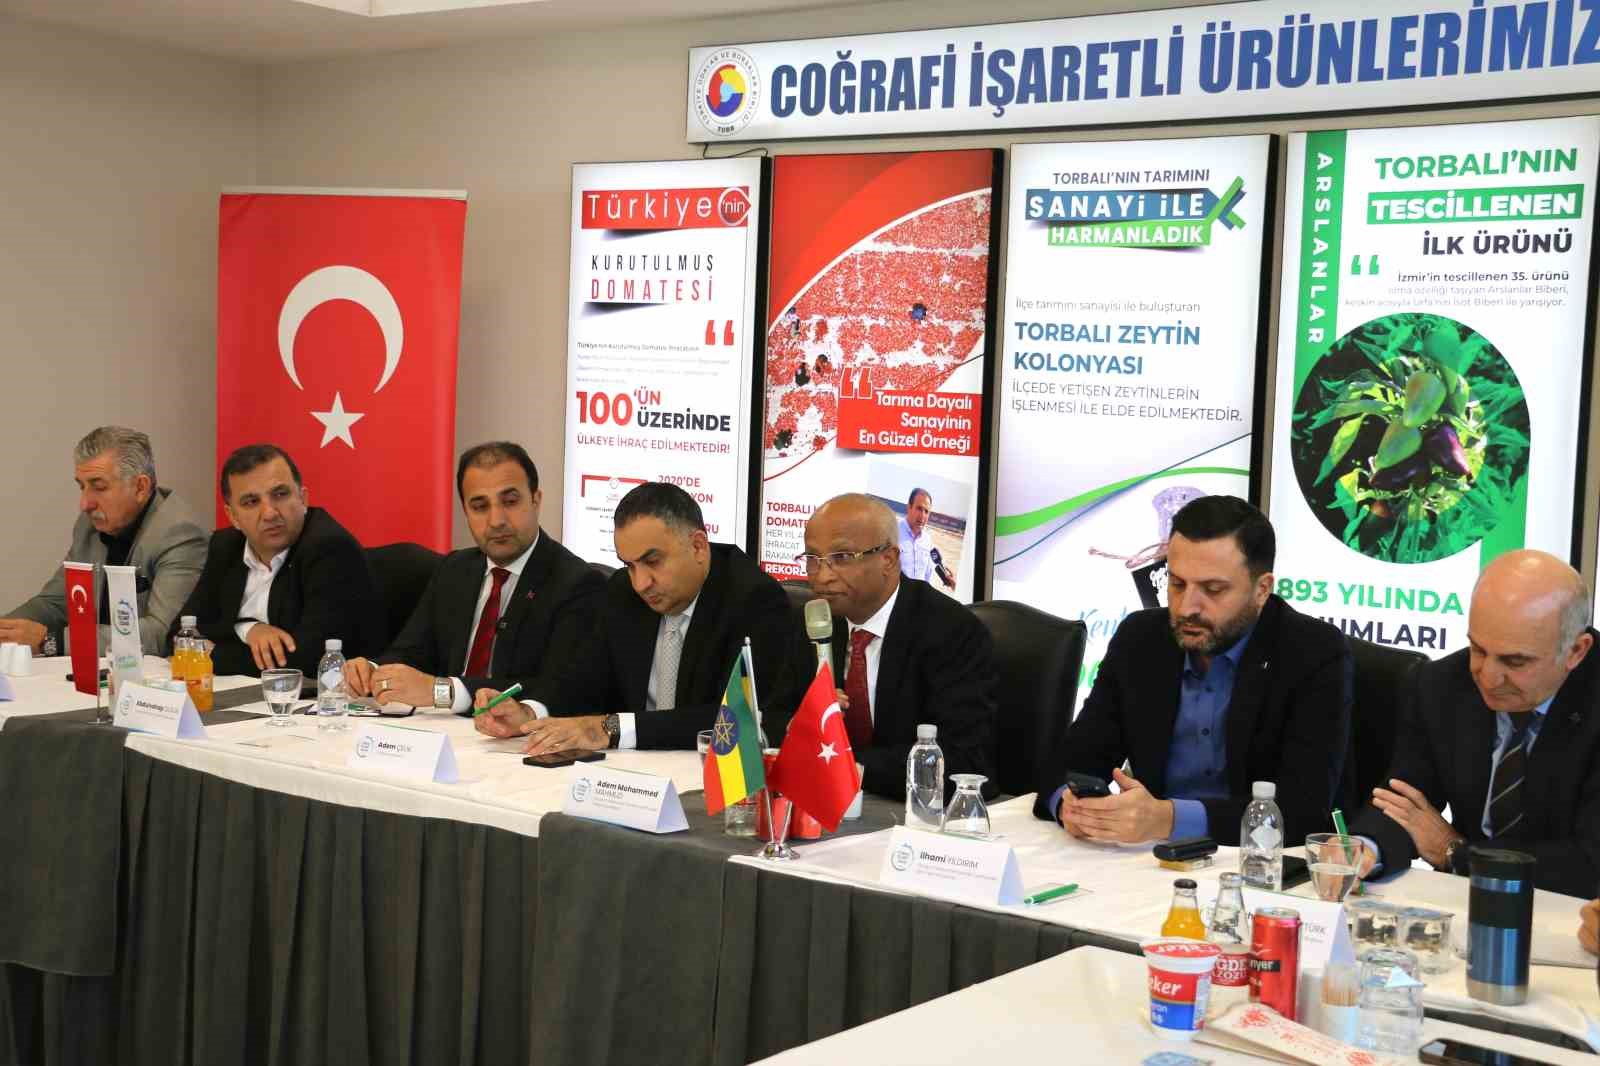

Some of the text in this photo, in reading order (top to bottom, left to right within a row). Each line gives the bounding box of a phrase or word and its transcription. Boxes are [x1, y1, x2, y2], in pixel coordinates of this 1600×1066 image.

[770, 44, 957, 118] COĞRAFİ
[969, 25, 1184, 118] İŞARETLİ
[1375, 148, 1577, 179] TORBALI'NIN
[1053, 169, 1210, 185] TORBALI'NIN TARIMINI
[587, 192, 712, 226] Türkiye
[1372, 190, 1577, 221] TESCİLLENEN
[1051, 225, 1204, 244] HARMANLADIK
[1423, 227, 1573, 256] İLK ÜRÜNÜ
[1309, 152, 1333, 343] ARSLANLAR
[592, 254, 713, 272] KURUTULMUŞ
[592, 276, 713, 301] DOMATESİ
[1511, 271, 1528, 281] 35.
[1015, 319, 1201, 346] TORBALI ZEYTİN
[1014, 351, 1143, 375] KOLONYASI
[876, 391, 972, 412] Tarıma Dayalı
[1012, 378, 1056, 396] İLÇEDE
[1114, 382, 1199, 401] ZEYTİNLERİN
[576, 391, 633, 427] 100
[637, 406, 731, 432] ÜZERİNDE
[901, 412, 972, 431] Sanayinin
[1102, 403, 1135, 417] ELDE
[577, 433, 614, 447] ÜLKEYE
[651, 438, 731, 455] EDİLMEKTEDİR!
[859, 429, 970, 454] En Güzel Örneği
[1337, 582, 1464, 616] YILINDA
